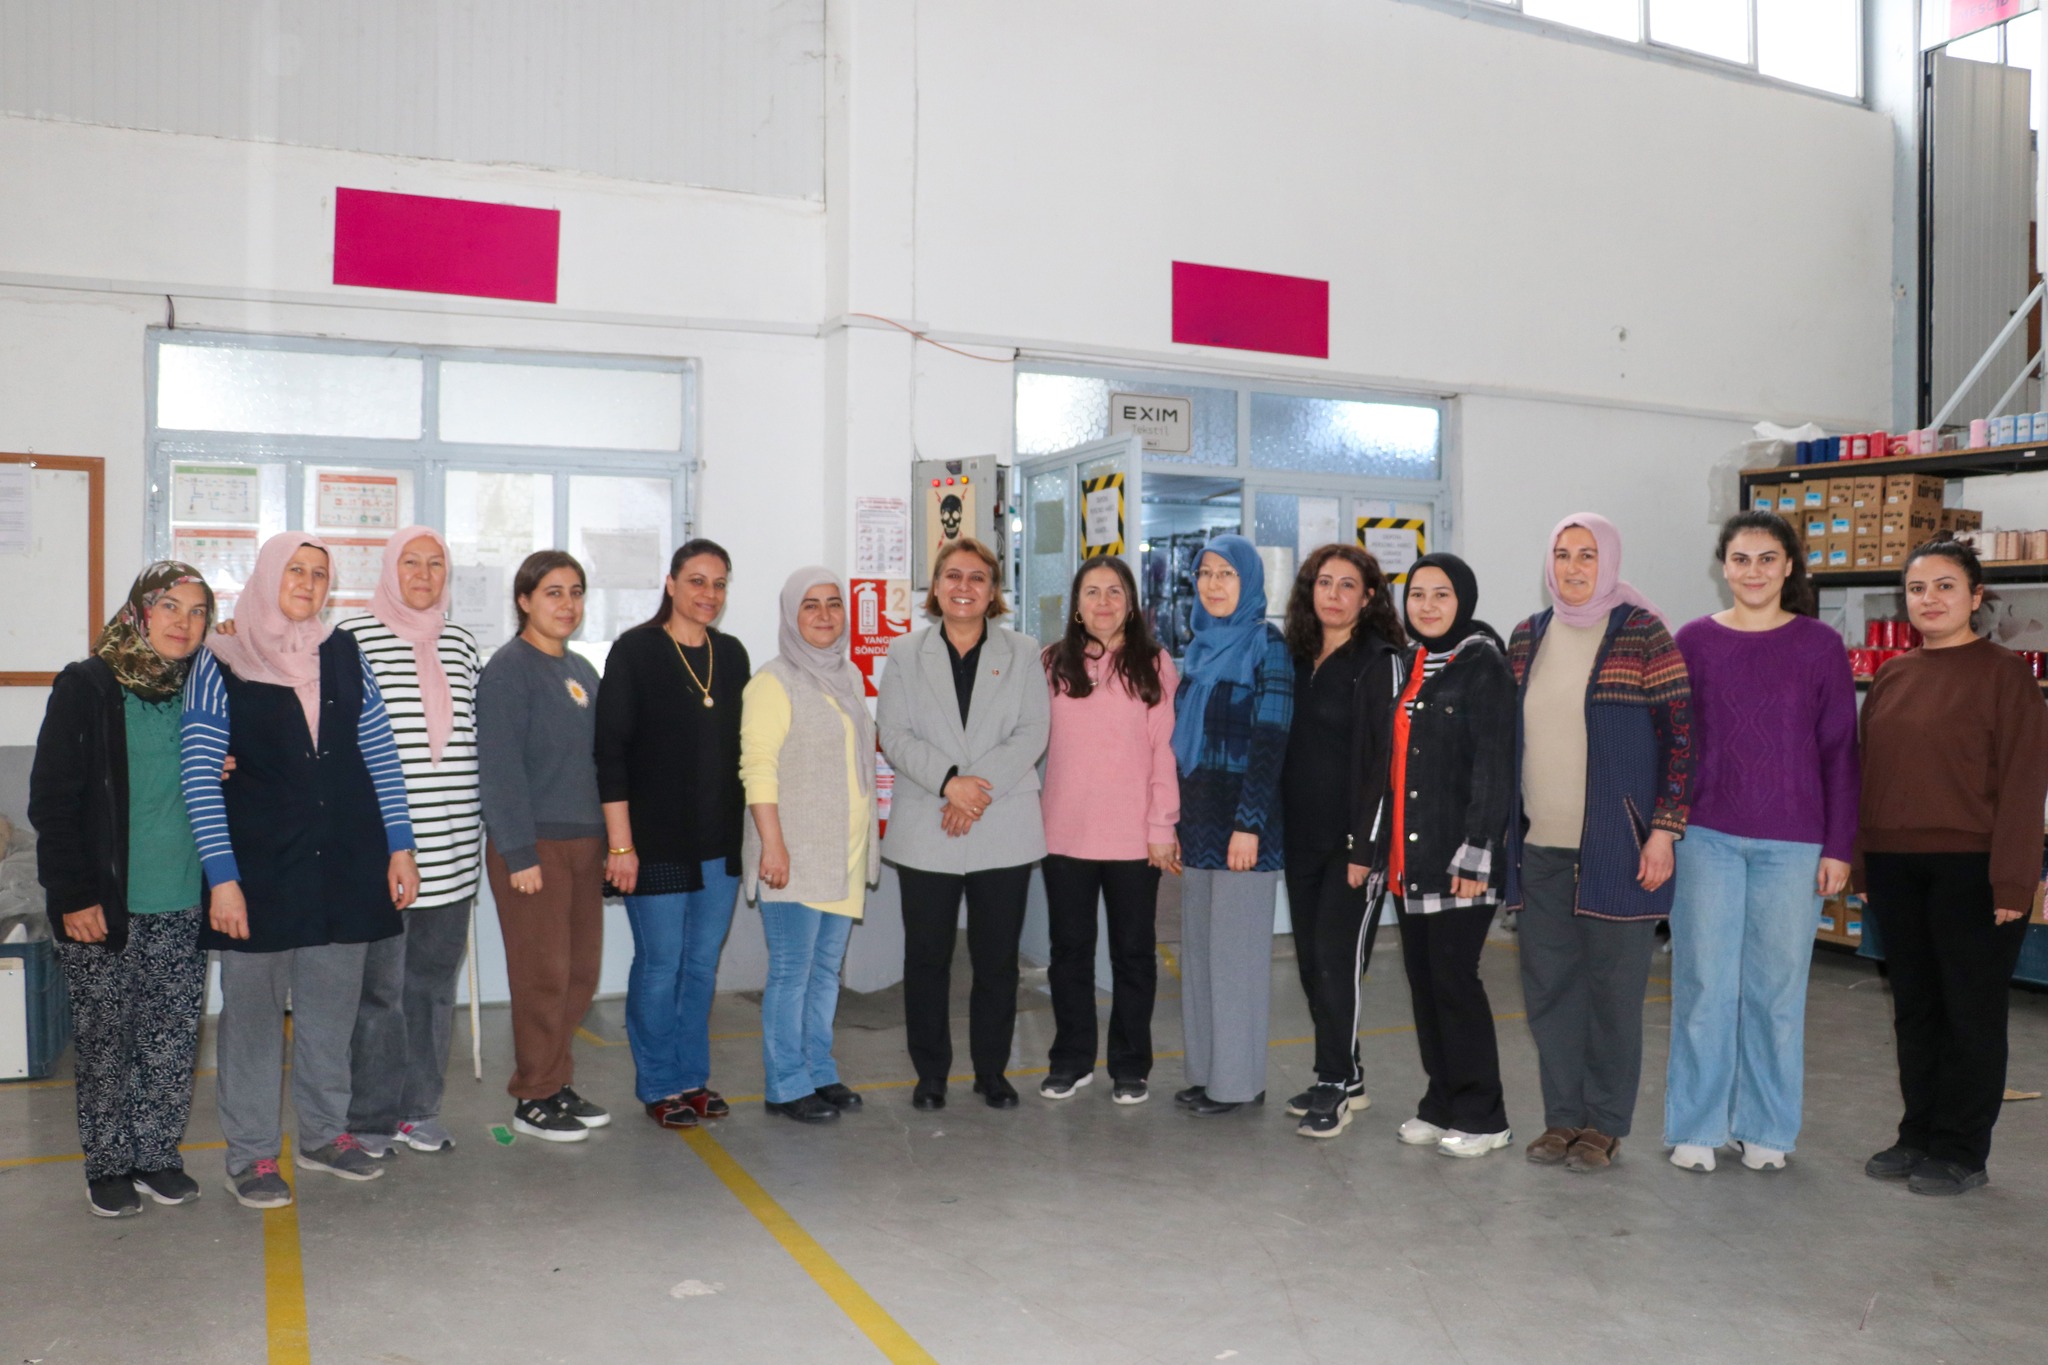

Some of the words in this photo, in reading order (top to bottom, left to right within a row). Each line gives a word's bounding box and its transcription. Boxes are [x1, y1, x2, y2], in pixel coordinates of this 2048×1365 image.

[1123, 406, 1178, 423] EXIM
[1911, 511, 1936, 531] tür-ip
[892, 587, 906, 611] 2
[864, 636, 893, 644] YANG
[855, 645, 887, 655] SÖNDÜ
